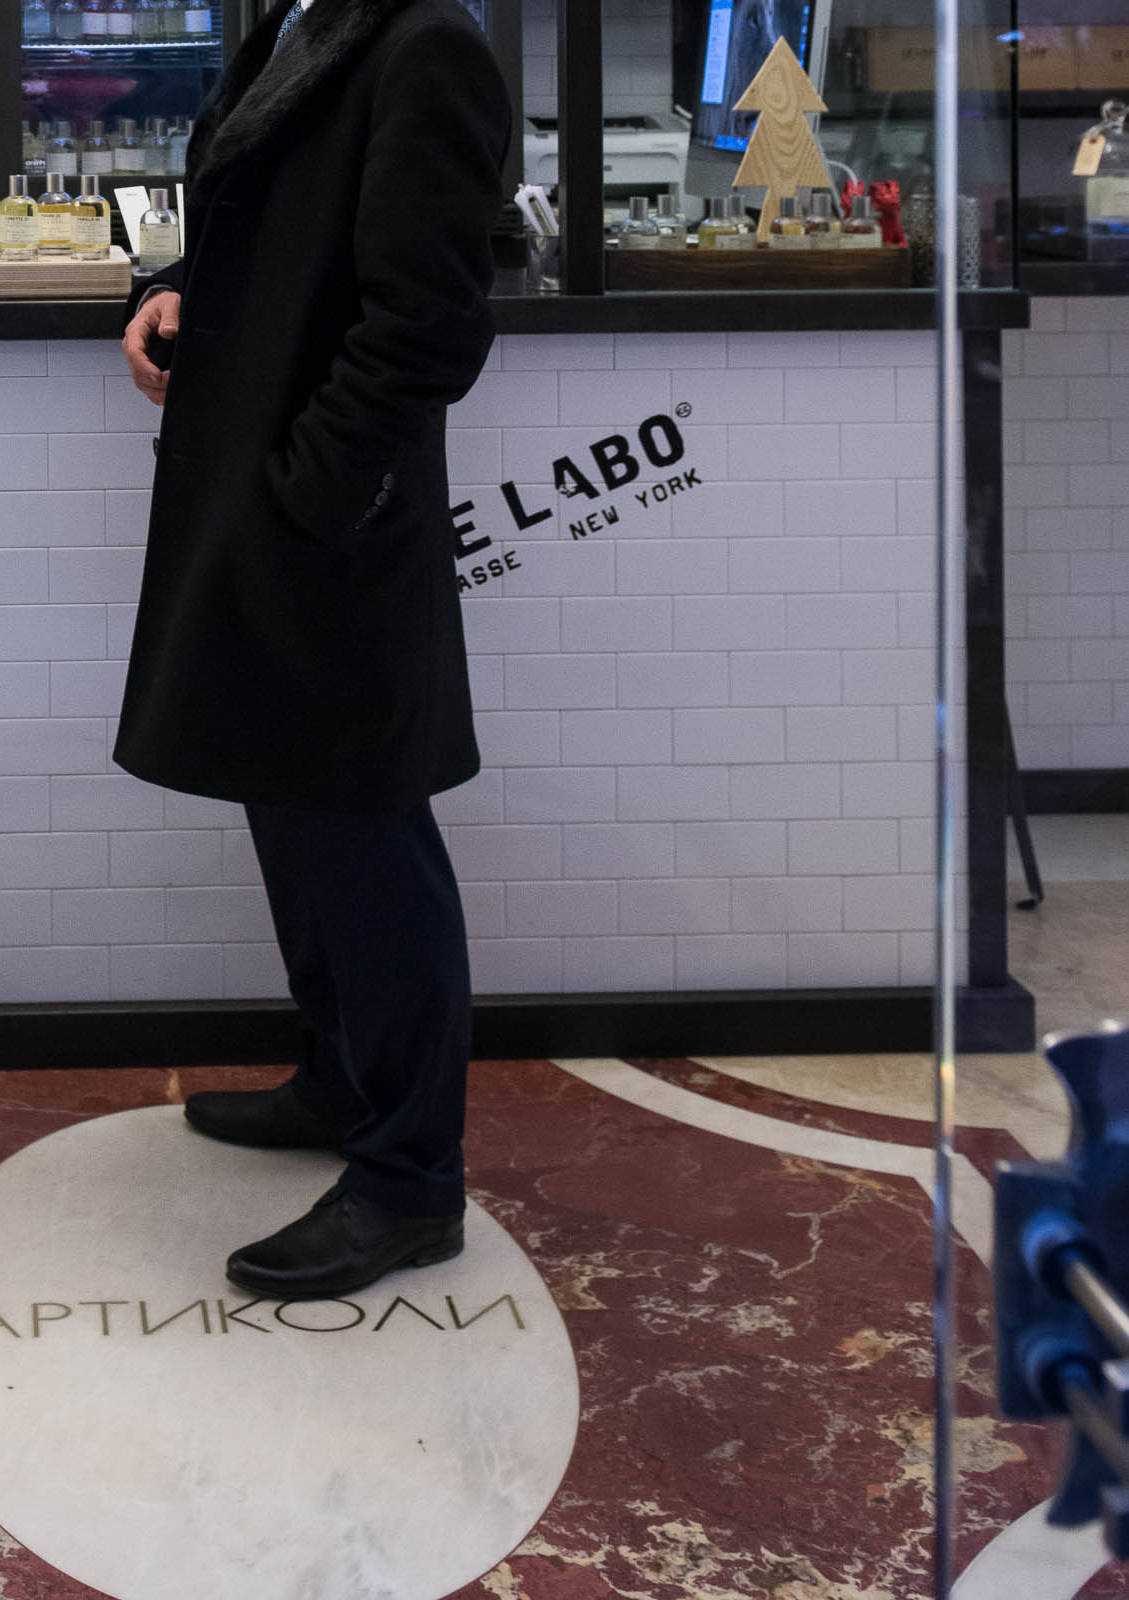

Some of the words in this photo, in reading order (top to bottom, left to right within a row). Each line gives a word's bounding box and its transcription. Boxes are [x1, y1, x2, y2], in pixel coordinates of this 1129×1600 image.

[500, 414, 685, 531] LABO
[568, 505, 620, 541] NEW
[634, 467, 703, 510] YORK
